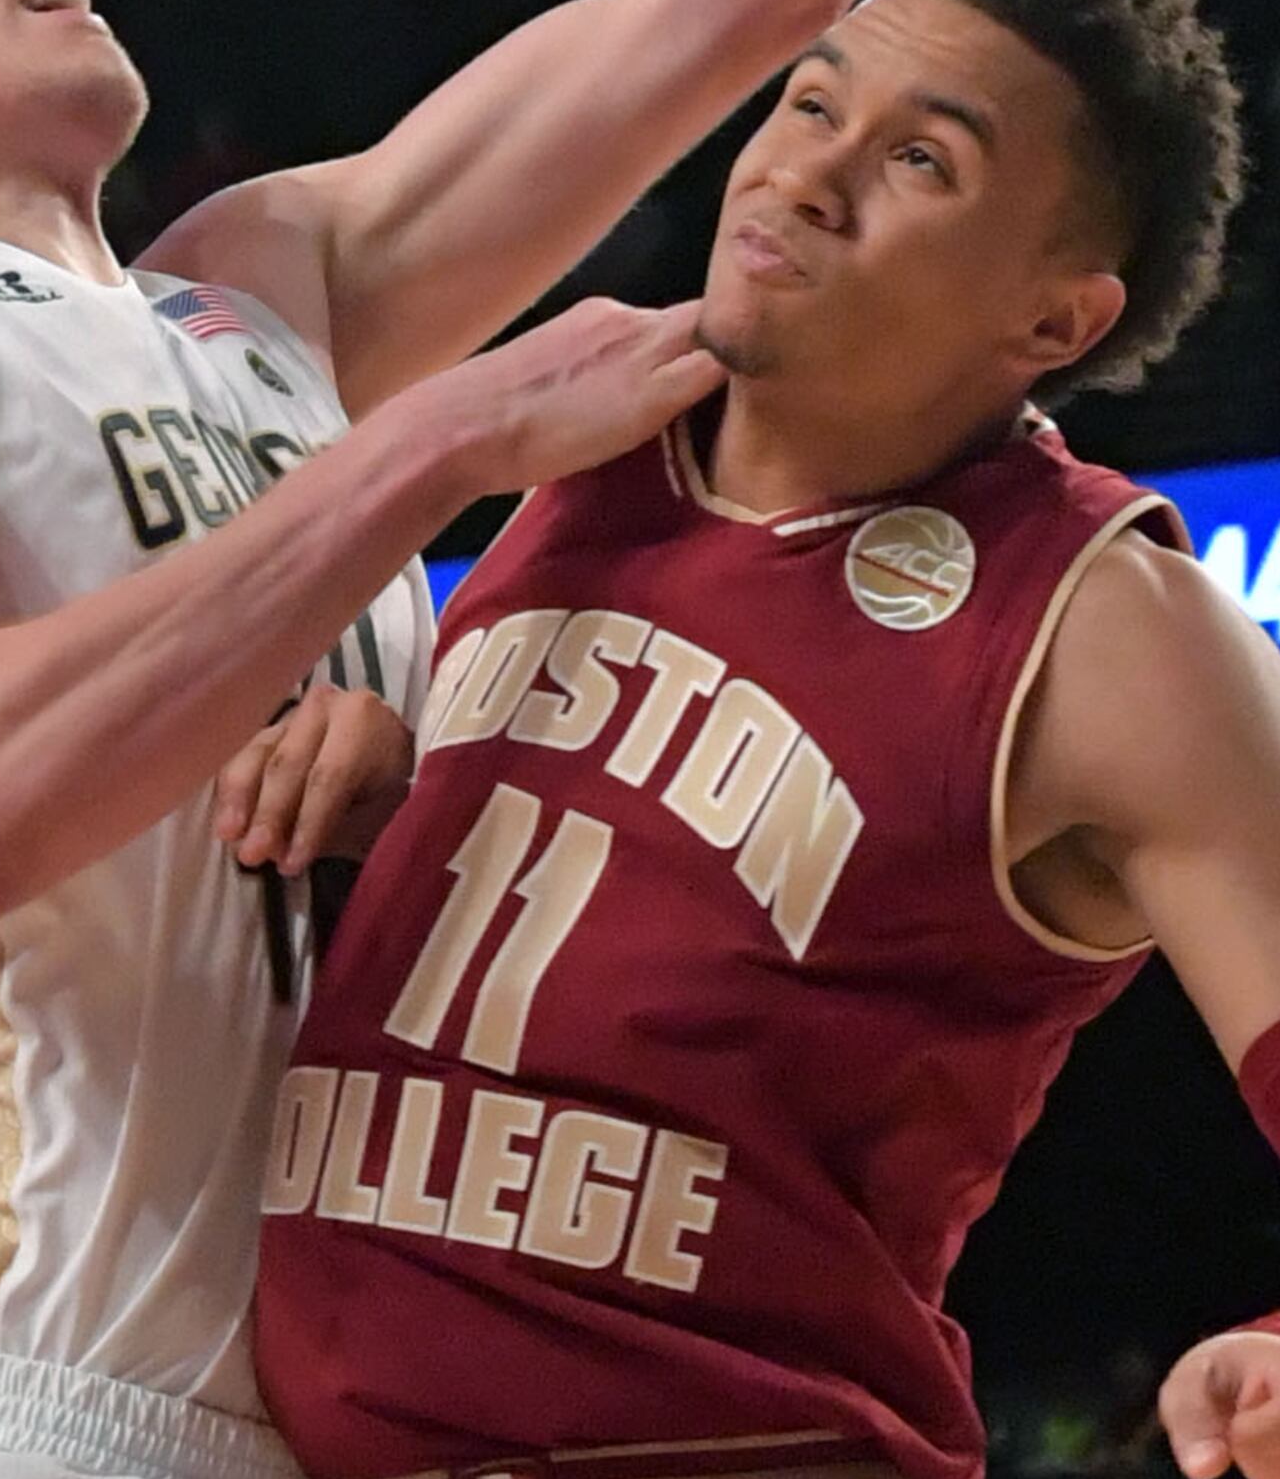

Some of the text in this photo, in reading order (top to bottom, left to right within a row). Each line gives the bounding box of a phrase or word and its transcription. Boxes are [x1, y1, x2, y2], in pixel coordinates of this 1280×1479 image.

[860, 541, 970, 590] ACC
[382, 782, 613, 1075] 11
[260, 1066, 728, 1294] OLLEGE
